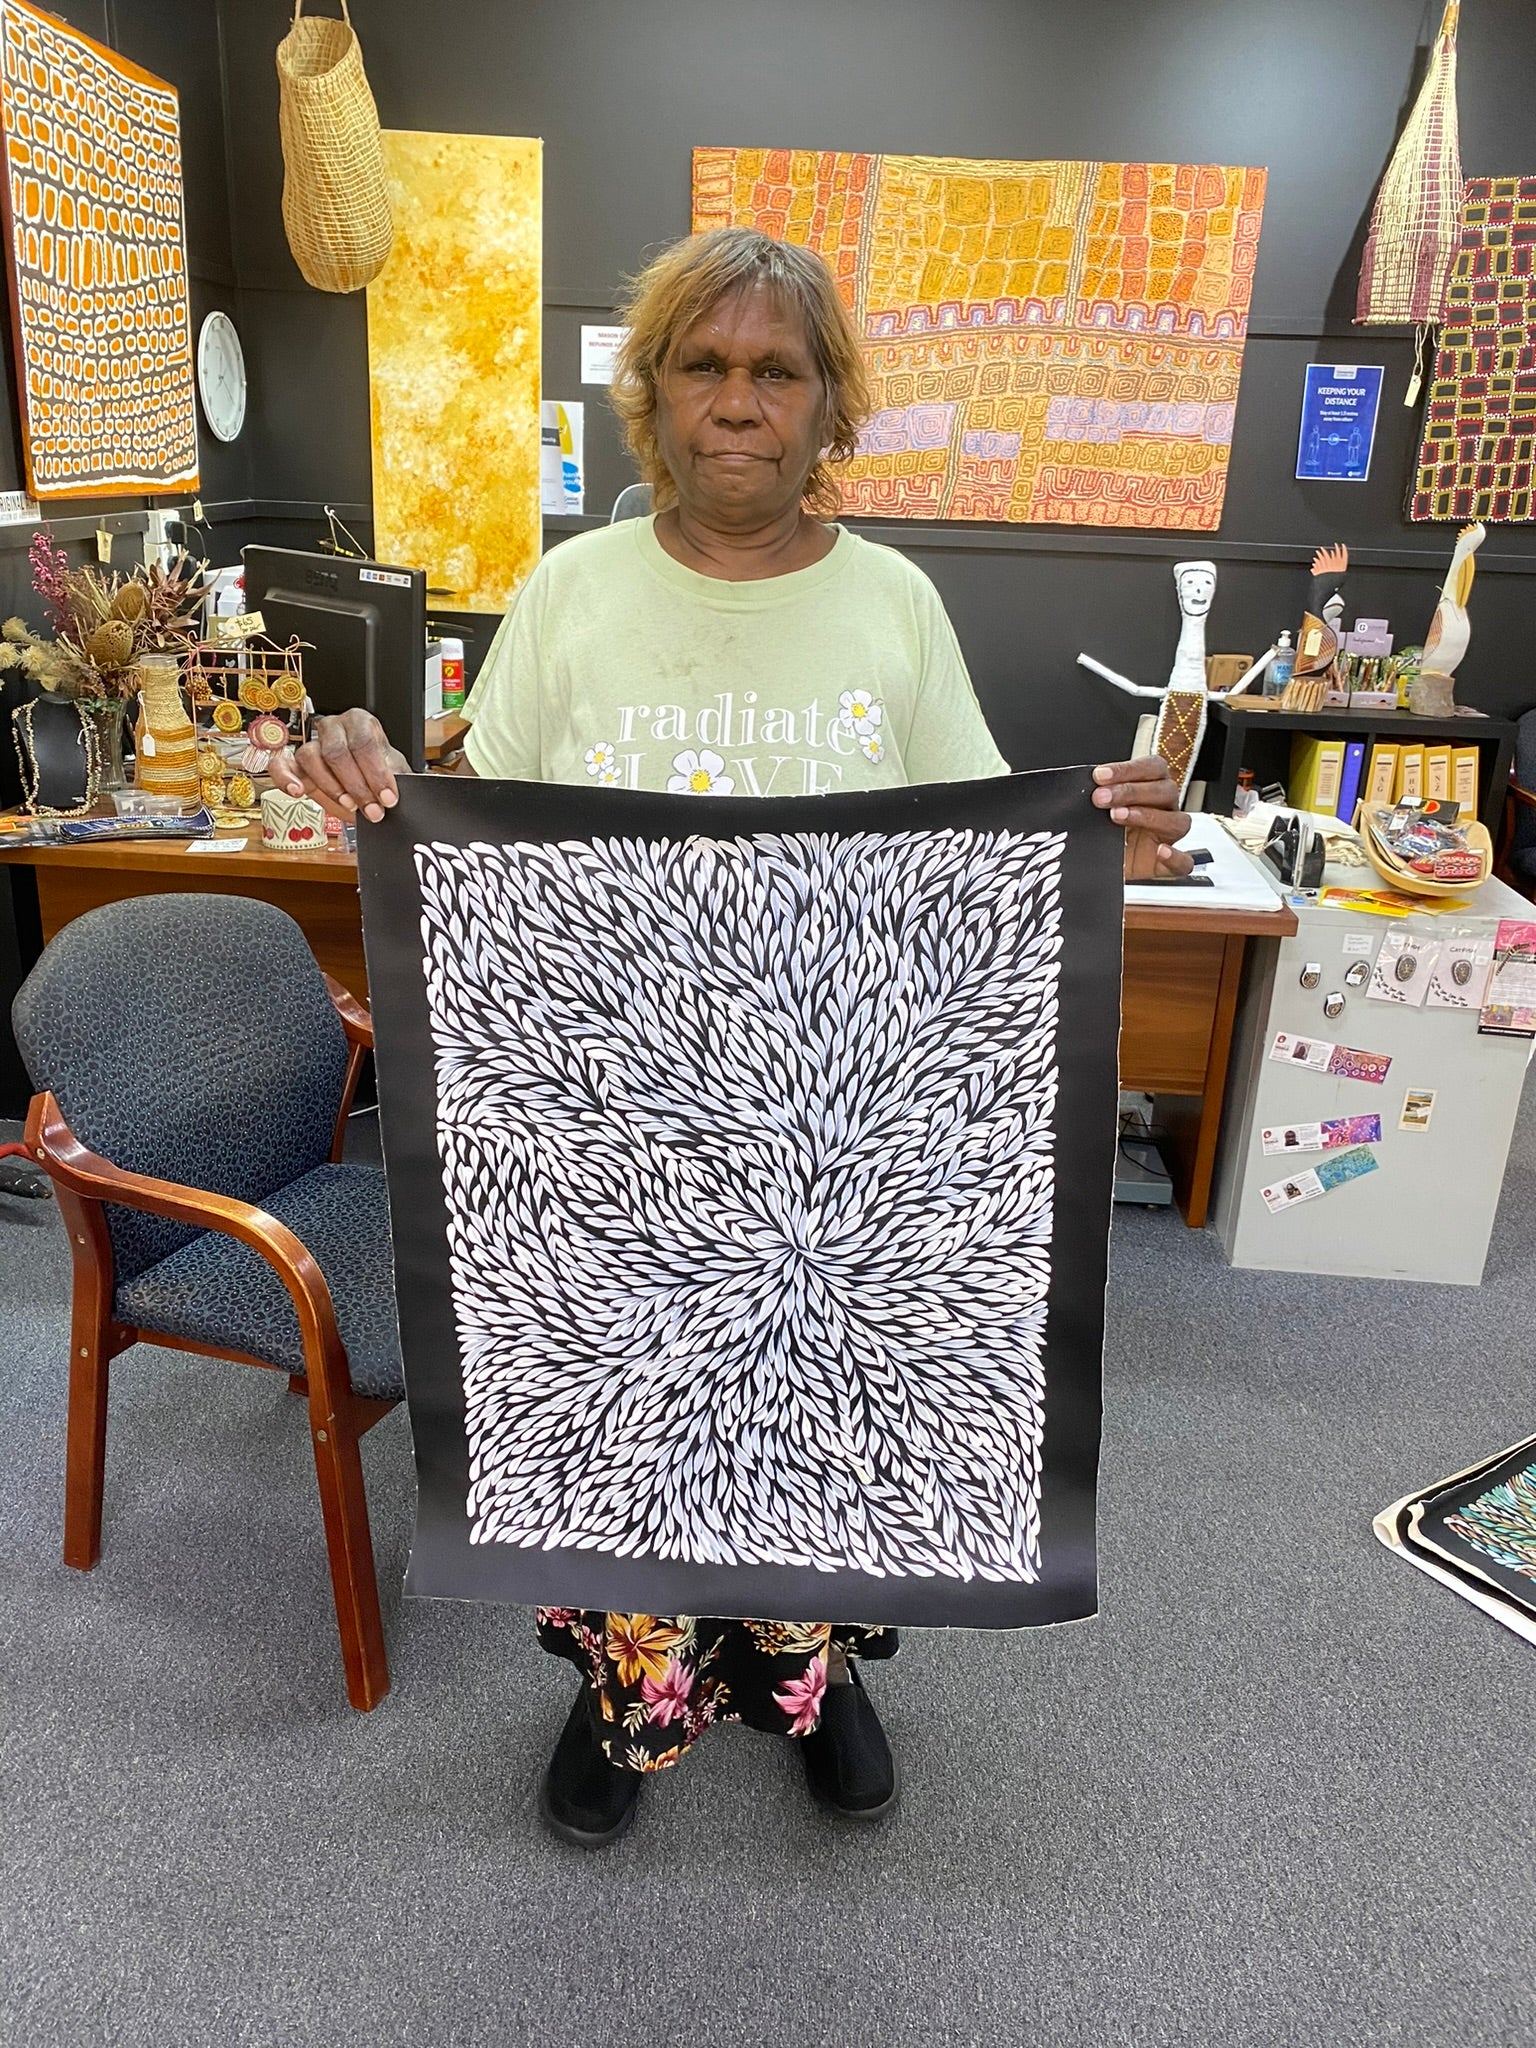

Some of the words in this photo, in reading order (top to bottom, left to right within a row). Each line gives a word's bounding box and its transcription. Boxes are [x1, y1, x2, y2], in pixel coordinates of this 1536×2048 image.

[1317, 386, 1346, 396] KEEPING
[1347, 387, 1366, 396] YOUR
[1324, 397, 1357, 406] DISTANCE
[616, 690, 858, 756] radiate
[618, 752, 843, 798] LVE
